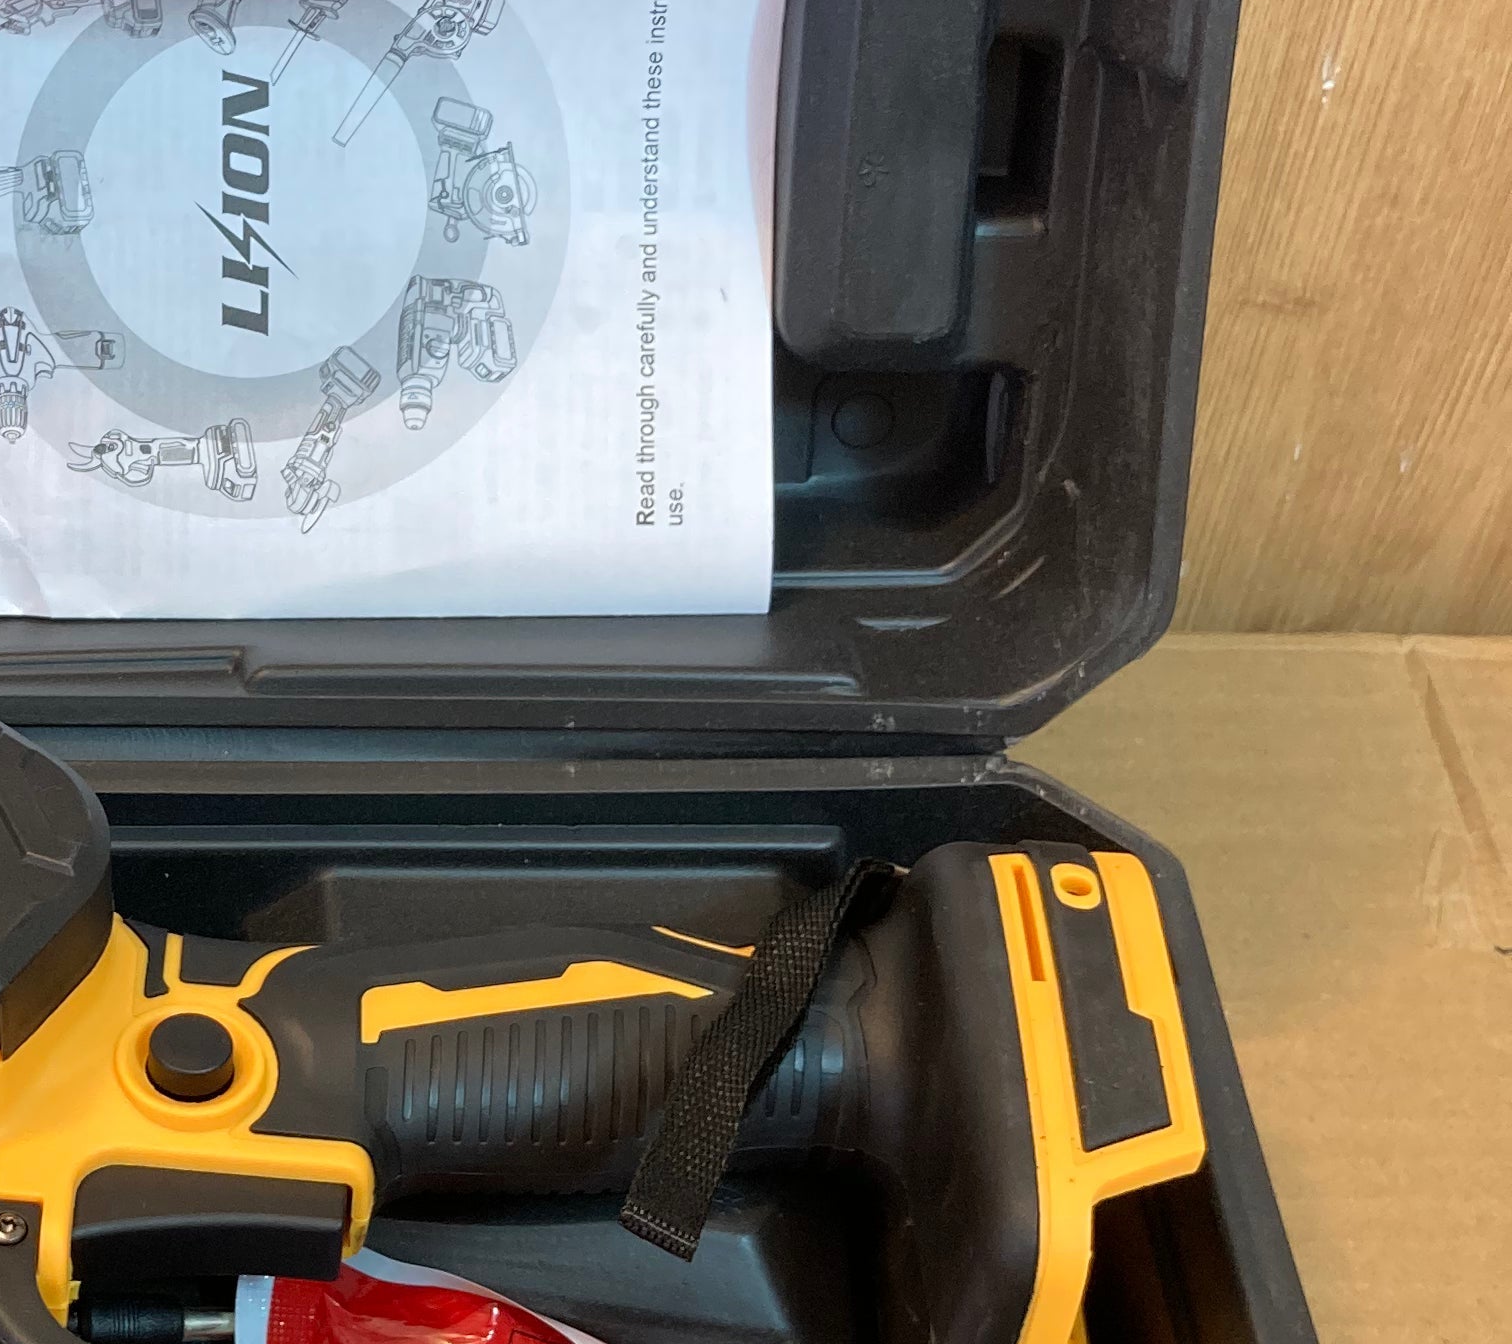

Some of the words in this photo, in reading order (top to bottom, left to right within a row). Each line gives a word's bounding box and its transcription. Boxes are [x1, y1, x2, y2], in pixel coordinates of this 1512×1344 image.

[642, 52, 663, 109] these
[639, 118, 660, 236] understand
[639, 244, 657, 283] and
[636, 289, 660, 377] carefully
[636, 385, 659, 464] through
[636, 471, 655, 526] Read
[669, 482, 684, 526] use.
